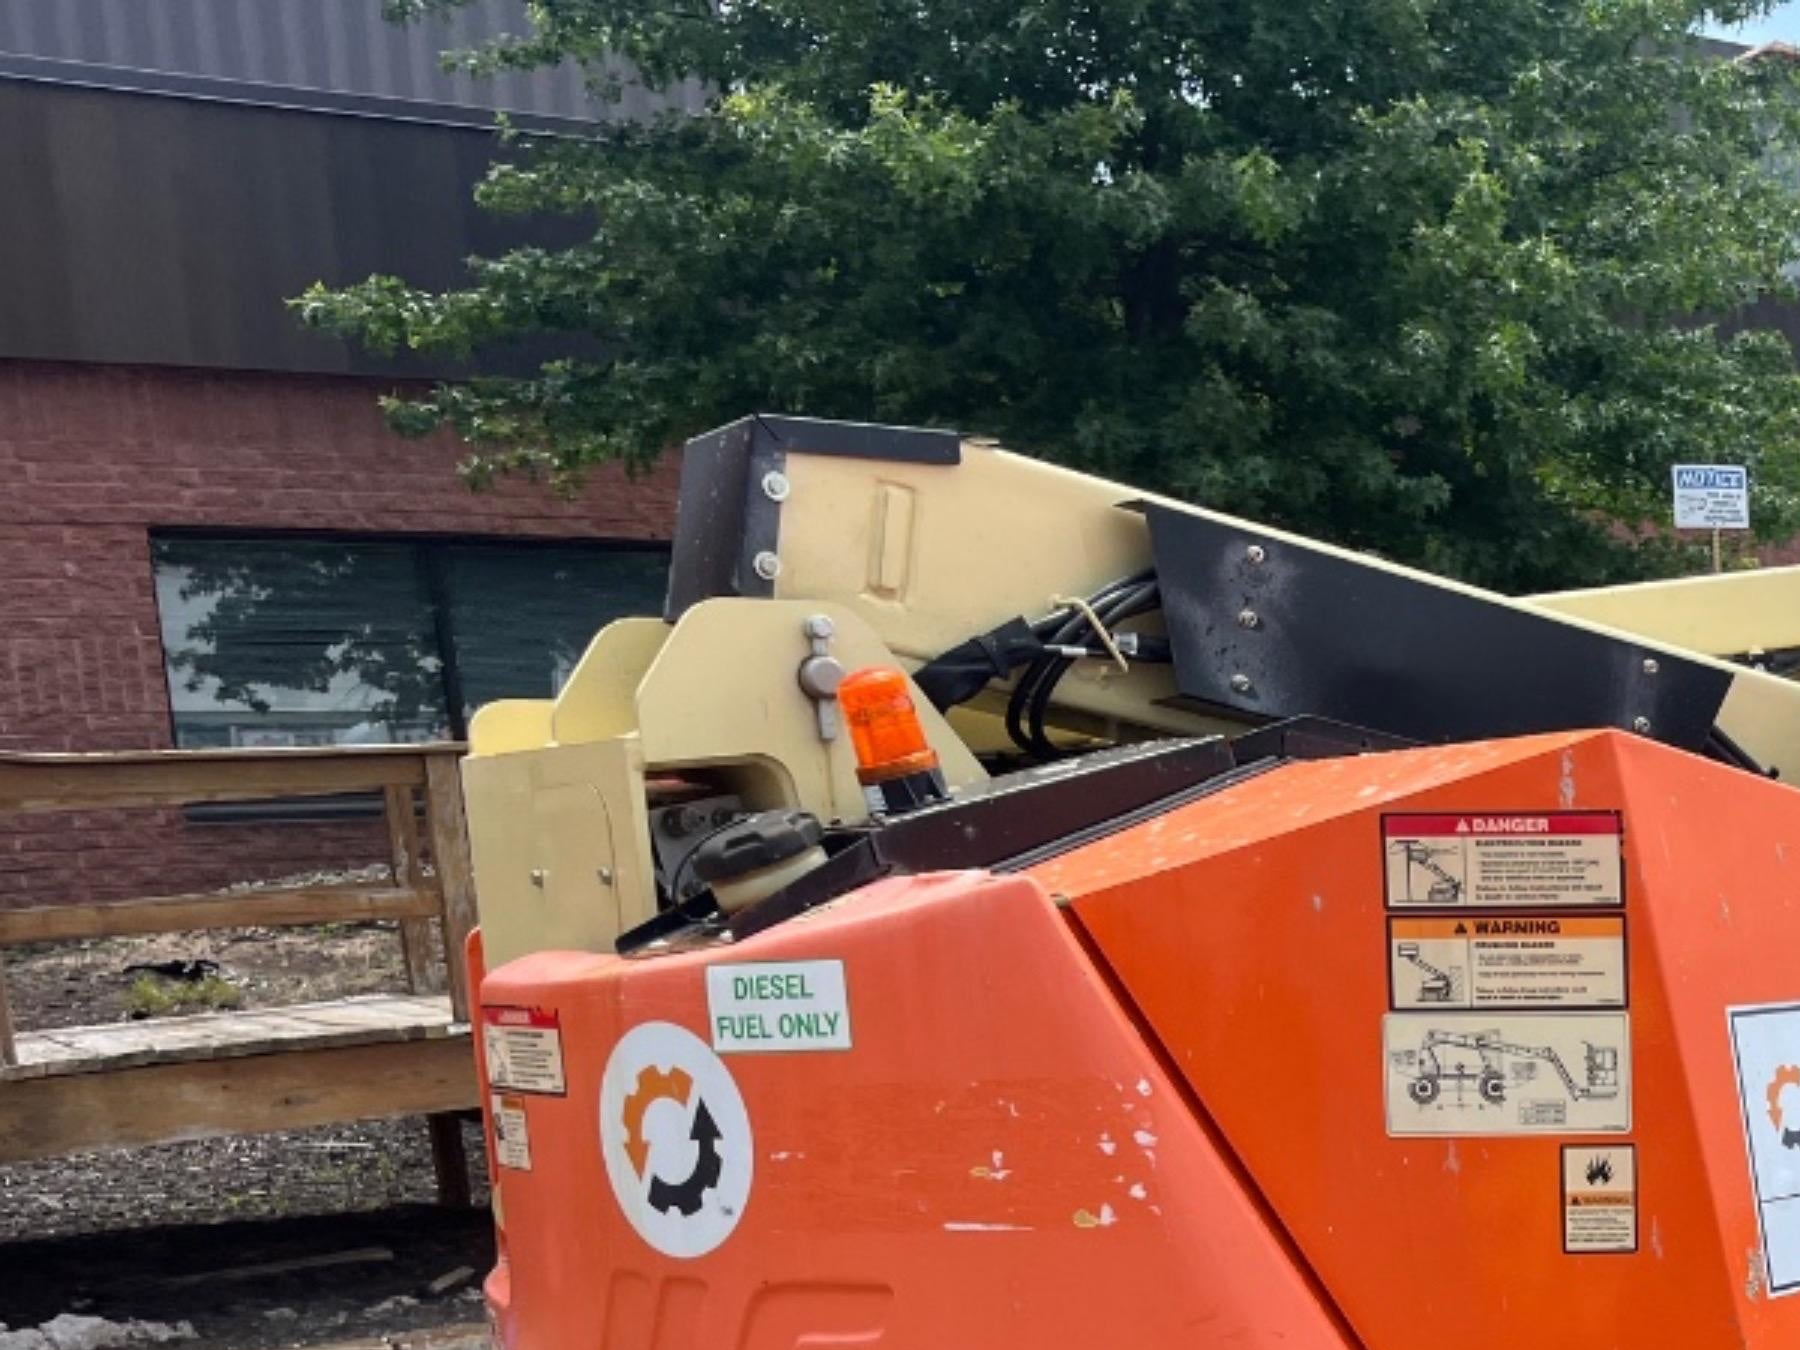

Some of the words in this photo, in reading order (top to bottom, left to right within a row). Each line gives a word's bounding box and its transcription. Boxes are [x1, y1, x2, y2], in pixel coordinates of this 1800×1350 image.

[1678, 470, 1743, 489] NOTICE
[1472, 818, 1550, 832] DANGER
[1475, 920, 1561, 934] WARNING
[733, 974, 815, 1001] DIESEL
[716, 1014, 774, 1040] FUEL
[778, 1011, 841, 1039] ONLY
